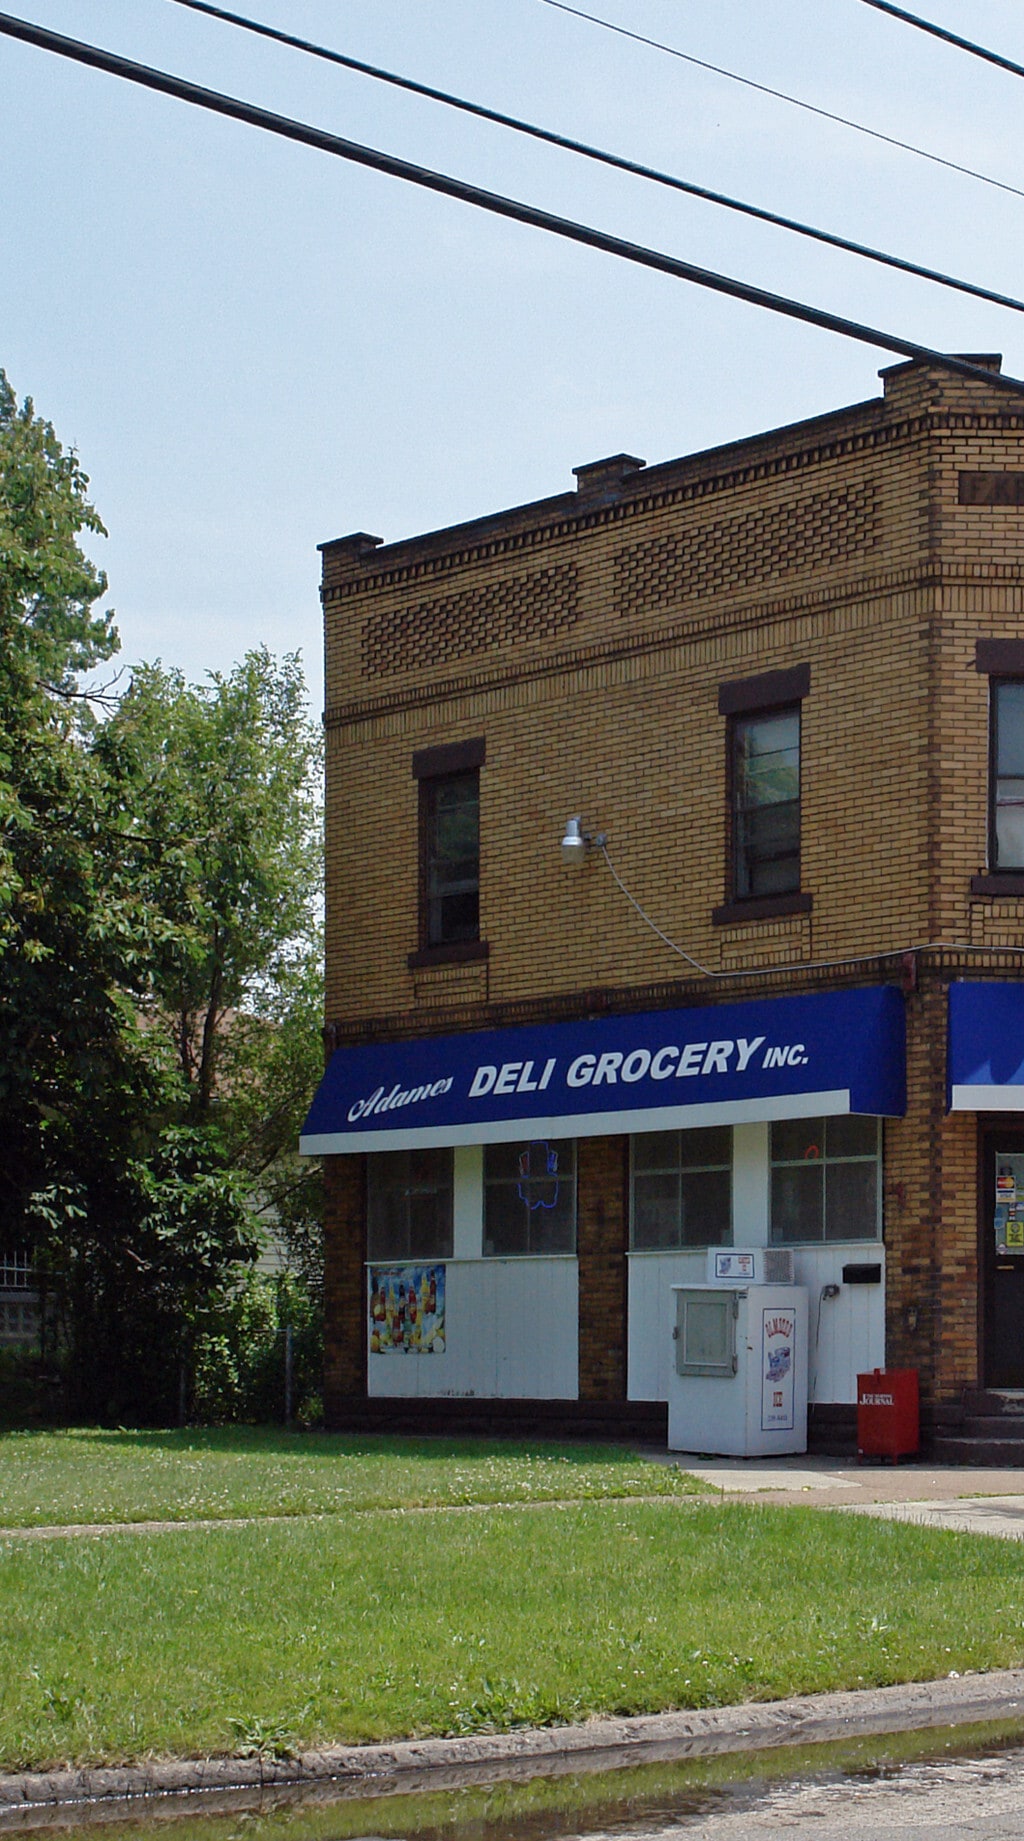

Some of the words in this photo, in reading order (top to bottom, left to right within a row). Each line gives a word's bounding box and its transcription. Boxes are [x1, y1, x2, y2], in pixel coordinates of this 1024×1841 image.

[468, 1058, 557, 1098] DELI
[566, 1036, 765, 1087] GROCERY
[762, 1043, 809, 1069] INC.
